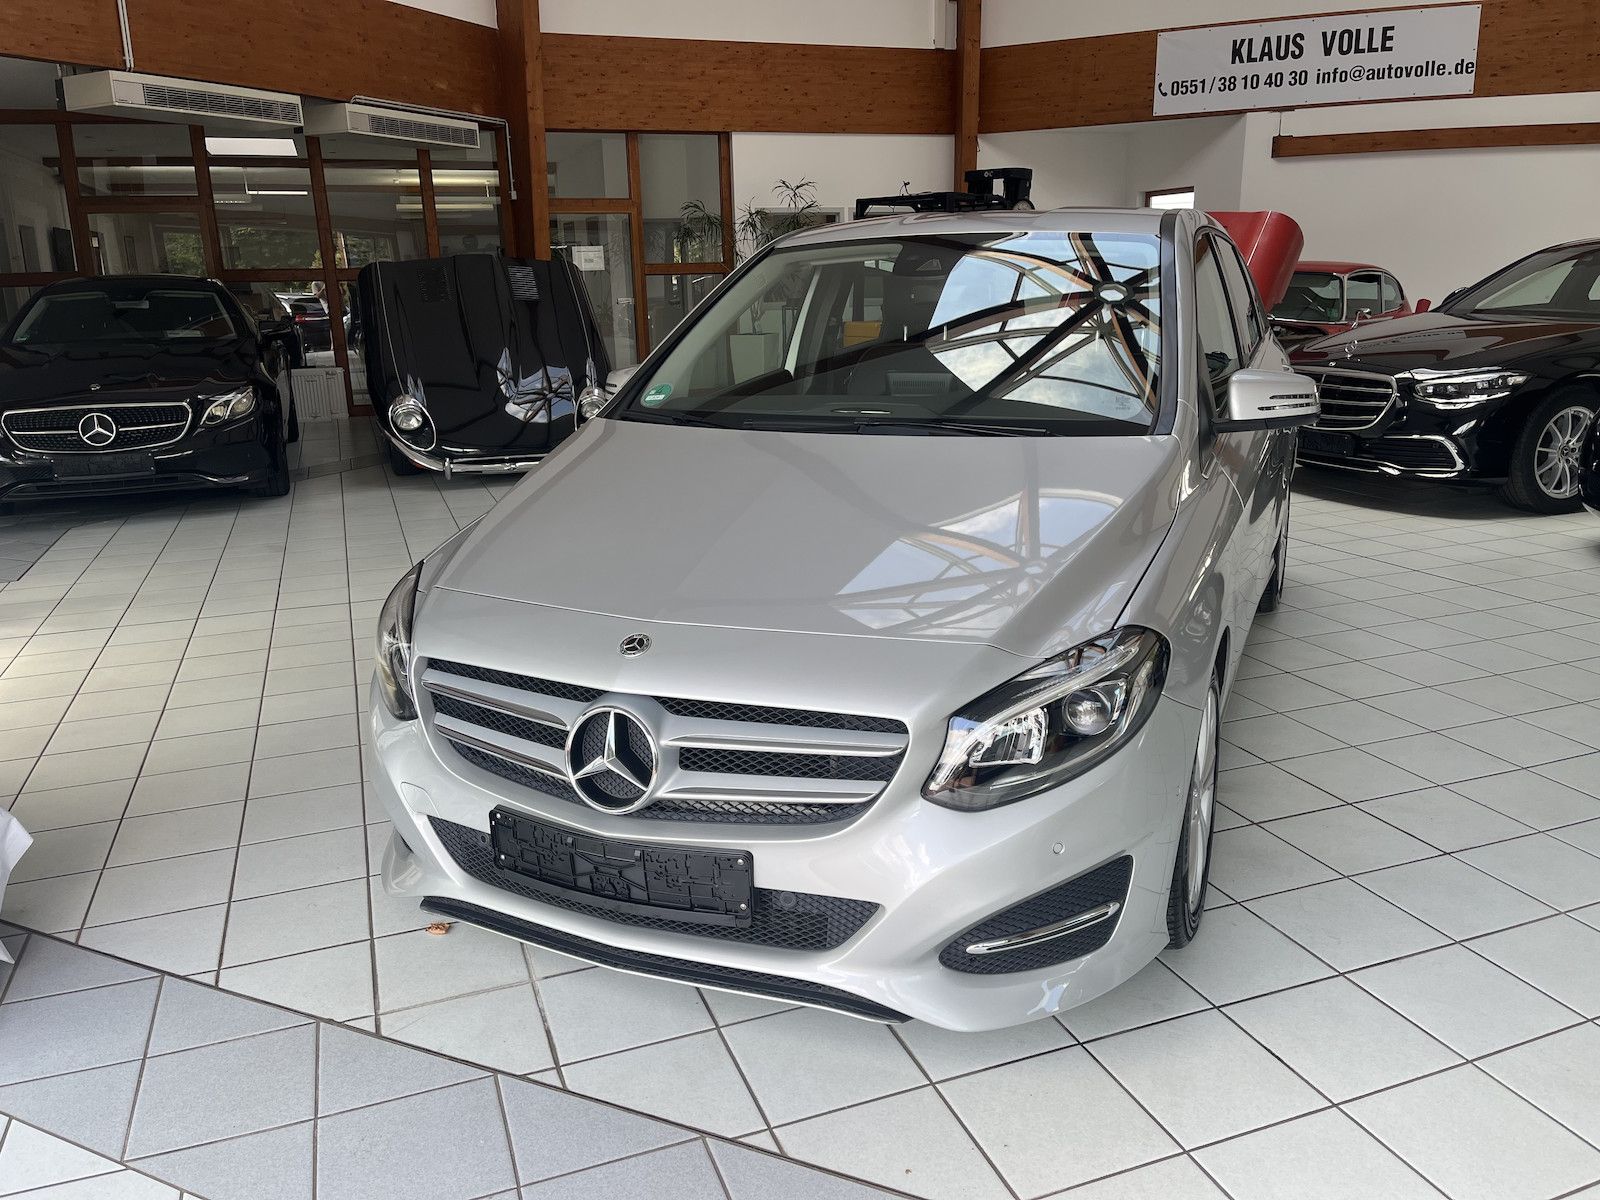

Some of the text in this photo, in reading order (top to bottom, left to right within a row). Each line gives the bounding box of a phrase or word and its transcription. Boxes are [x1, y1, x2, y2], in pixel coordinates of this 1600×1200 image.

[1231, 25, 1395, 64] KLAUS VOLLE
[1241, 73, 1260, 90] 10
[1264, 71, 1284, 88] 40
[1288, 69, 1308, 86] 30
[1316, 58, 1475, 85] info@autovolle.de
